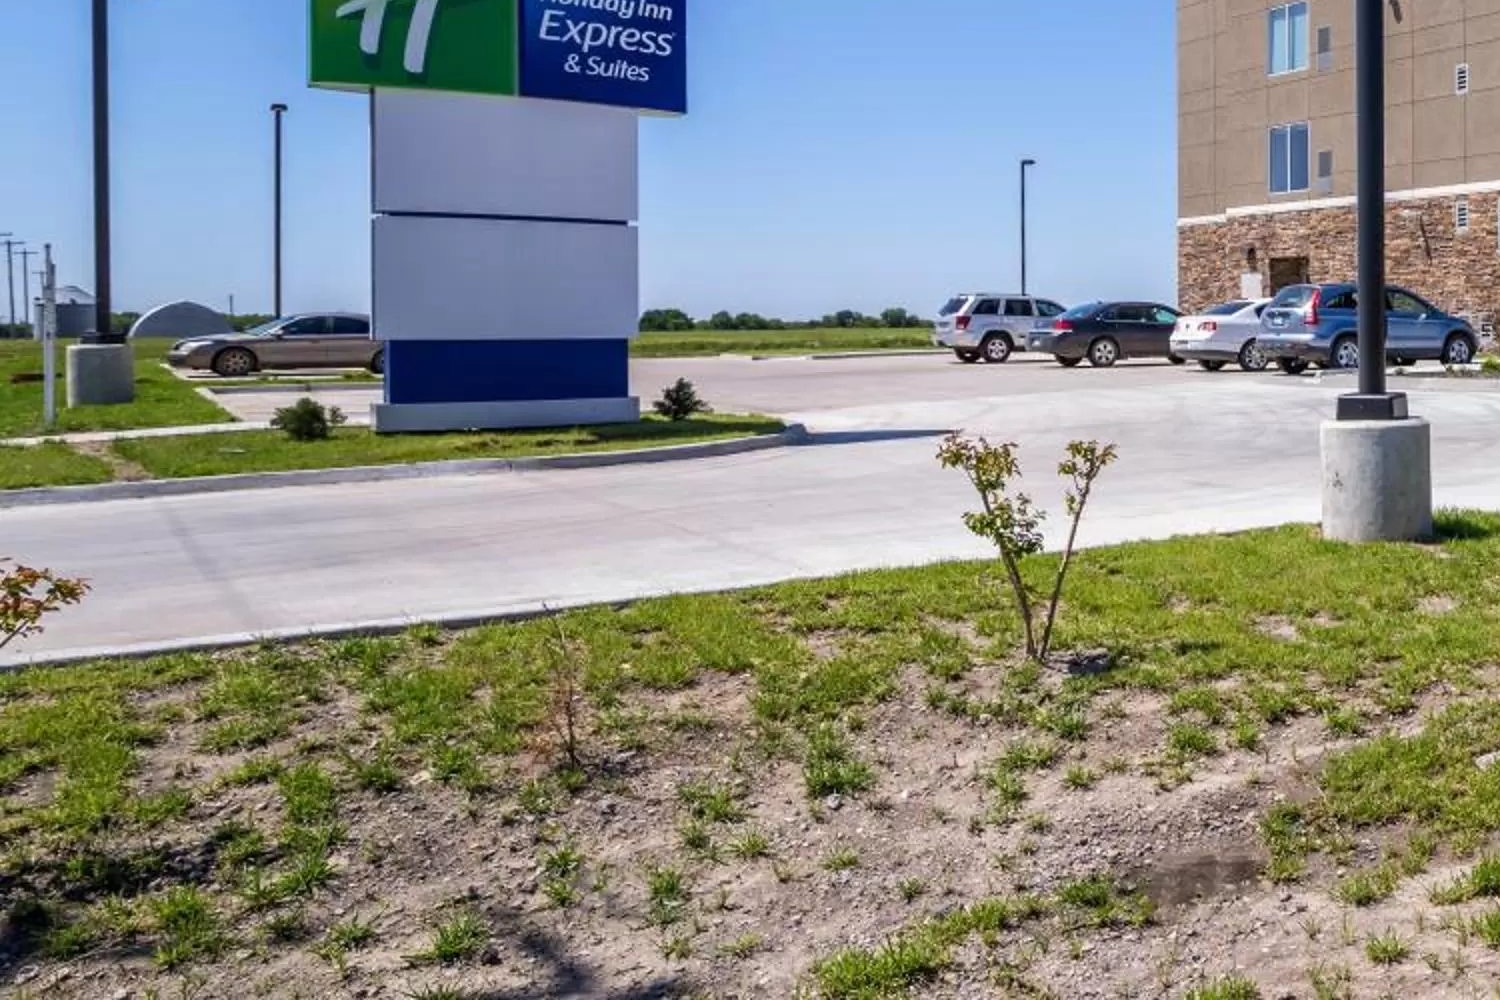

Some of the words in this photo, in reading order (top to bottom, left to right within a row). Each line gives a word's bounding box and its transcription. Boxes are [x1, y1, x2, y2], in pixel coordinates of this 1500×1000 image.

[539, 9, 673, 57] Express
[564, 53, 581, 73] &
[586, 56, 650, 82] Suites
